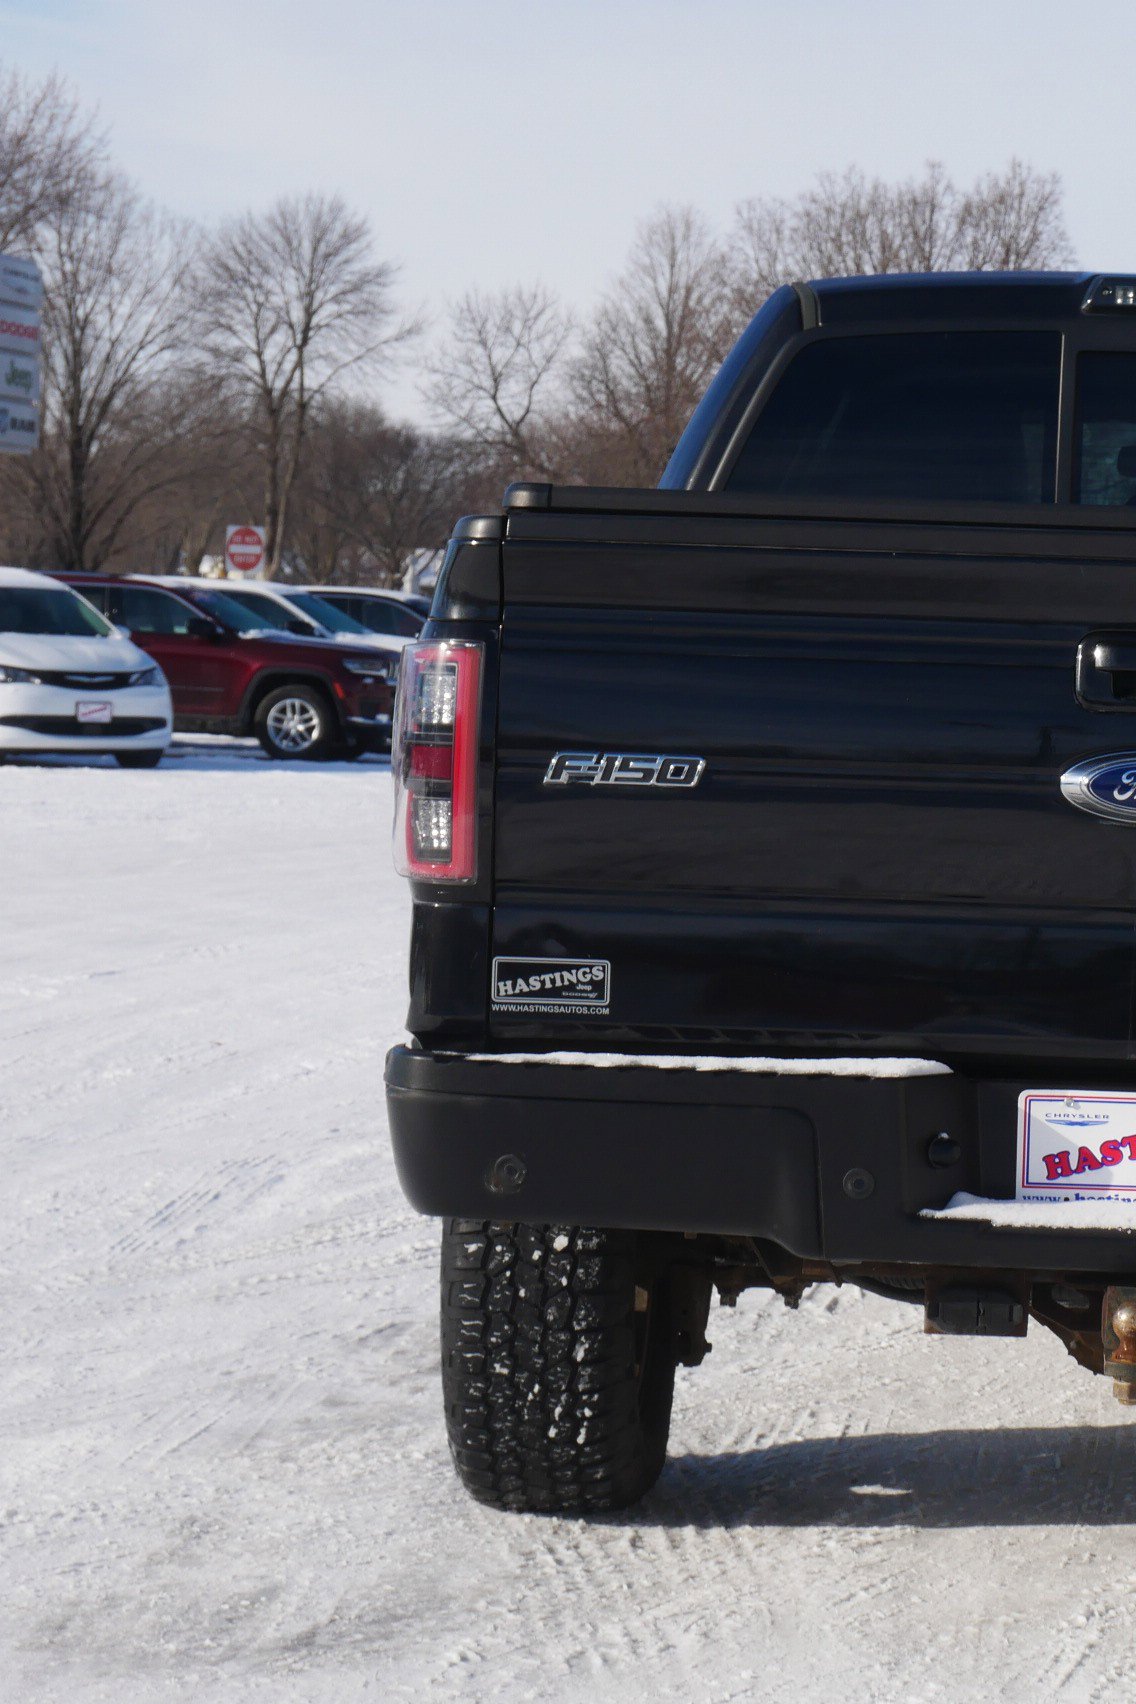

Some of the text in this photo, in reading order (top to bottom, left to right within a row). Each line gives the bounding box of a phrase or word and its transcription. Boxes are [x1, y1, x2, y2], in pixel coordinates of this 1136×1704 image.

[498, 965, 604, 996] HASTINGS
[492, 1003, 610, 1015] WWW.HASTINGSAUTOS.COM
[1045, 1112, 1110, 1120] CHRYSLER
